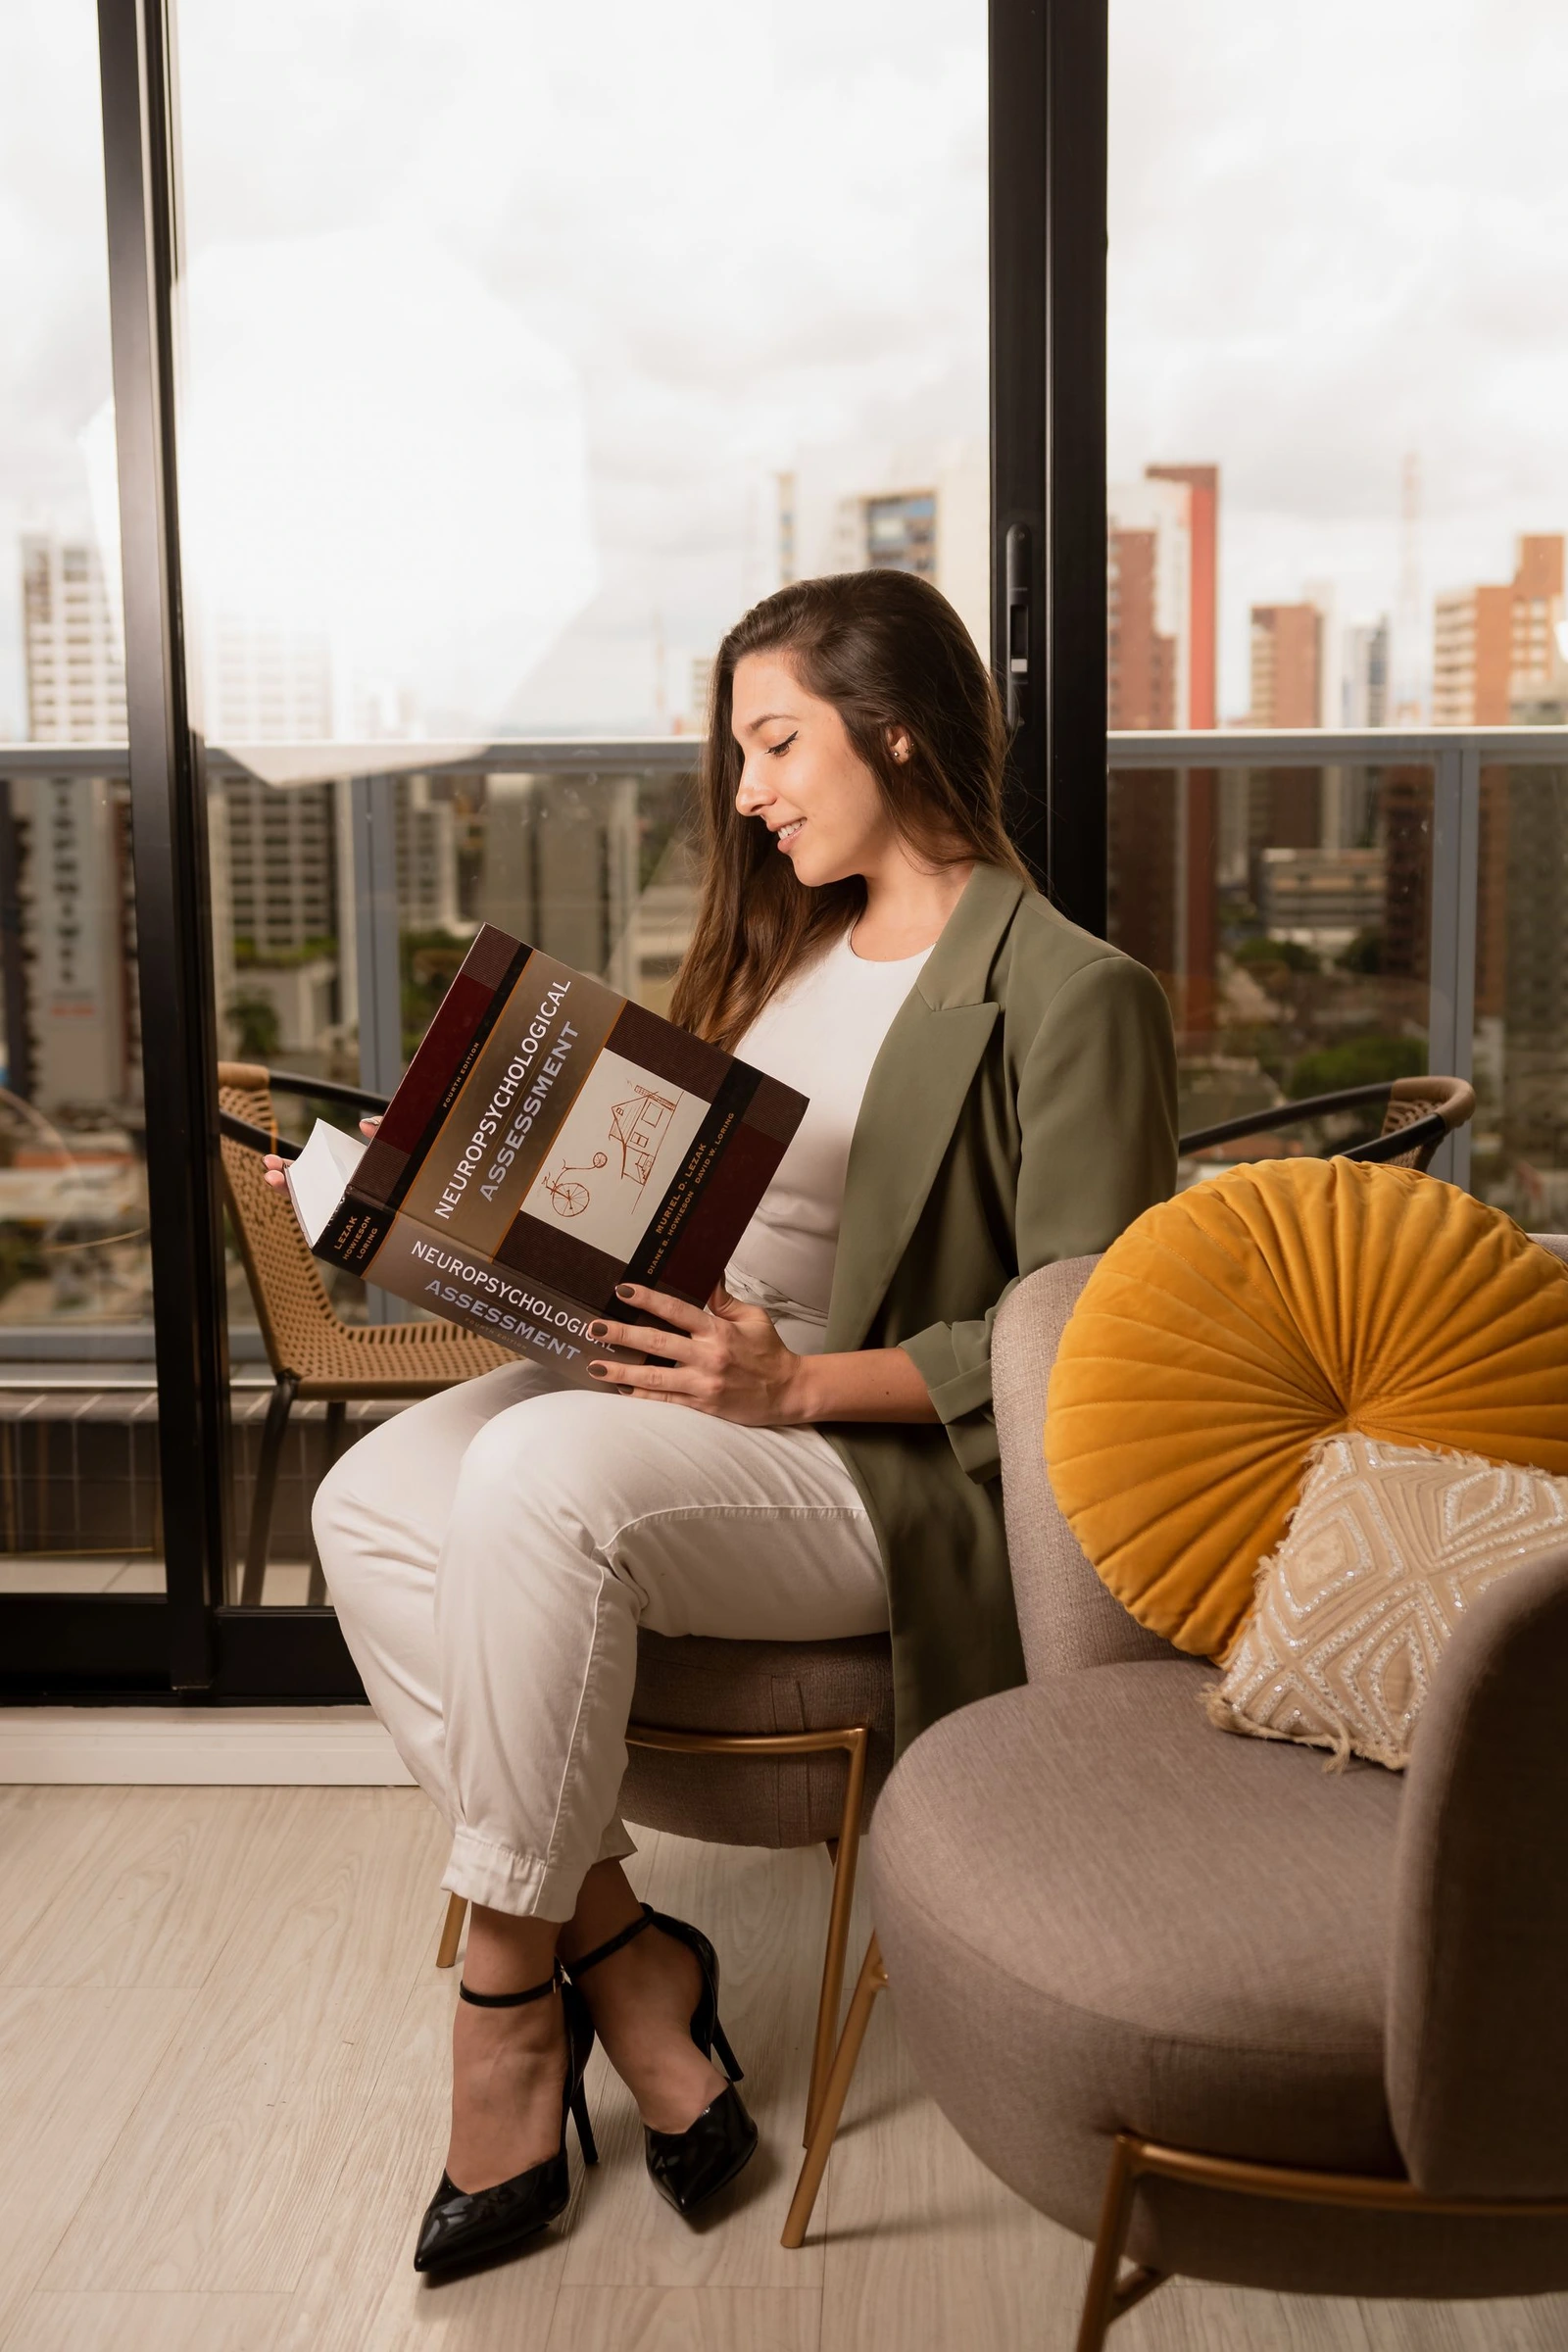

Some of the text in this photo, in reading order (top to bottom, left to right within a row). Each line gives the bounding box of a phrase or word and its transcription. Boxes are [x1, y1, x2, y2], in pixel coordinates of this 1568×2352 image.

[434, 977, 571, 1219] NEUROPSYCHOLOGICAL
[442, 1042, 480, 1108] FOURTH EDITION
[479, 1020, 580, 1202] ASSESSMENT
[647, 1248, 664, 1275] DIANE
[667, 1191, 694, 1237] HOWIESON
[695, 1157, 710, 1184] DAVID
[708, 1148, 717, 1157] W.
[714, 1112, 735, 1146] LORING
[656, 1143, 707, 1235] MURIEL D. LEZAK
[334, 1215, 358, 1250] LEZAK
[343, 1215, 371, 1260] HOWIESON
[356, 1228, 378, 1259] LORING
[424, 1278, 581, 1360] ASSESSMENT
